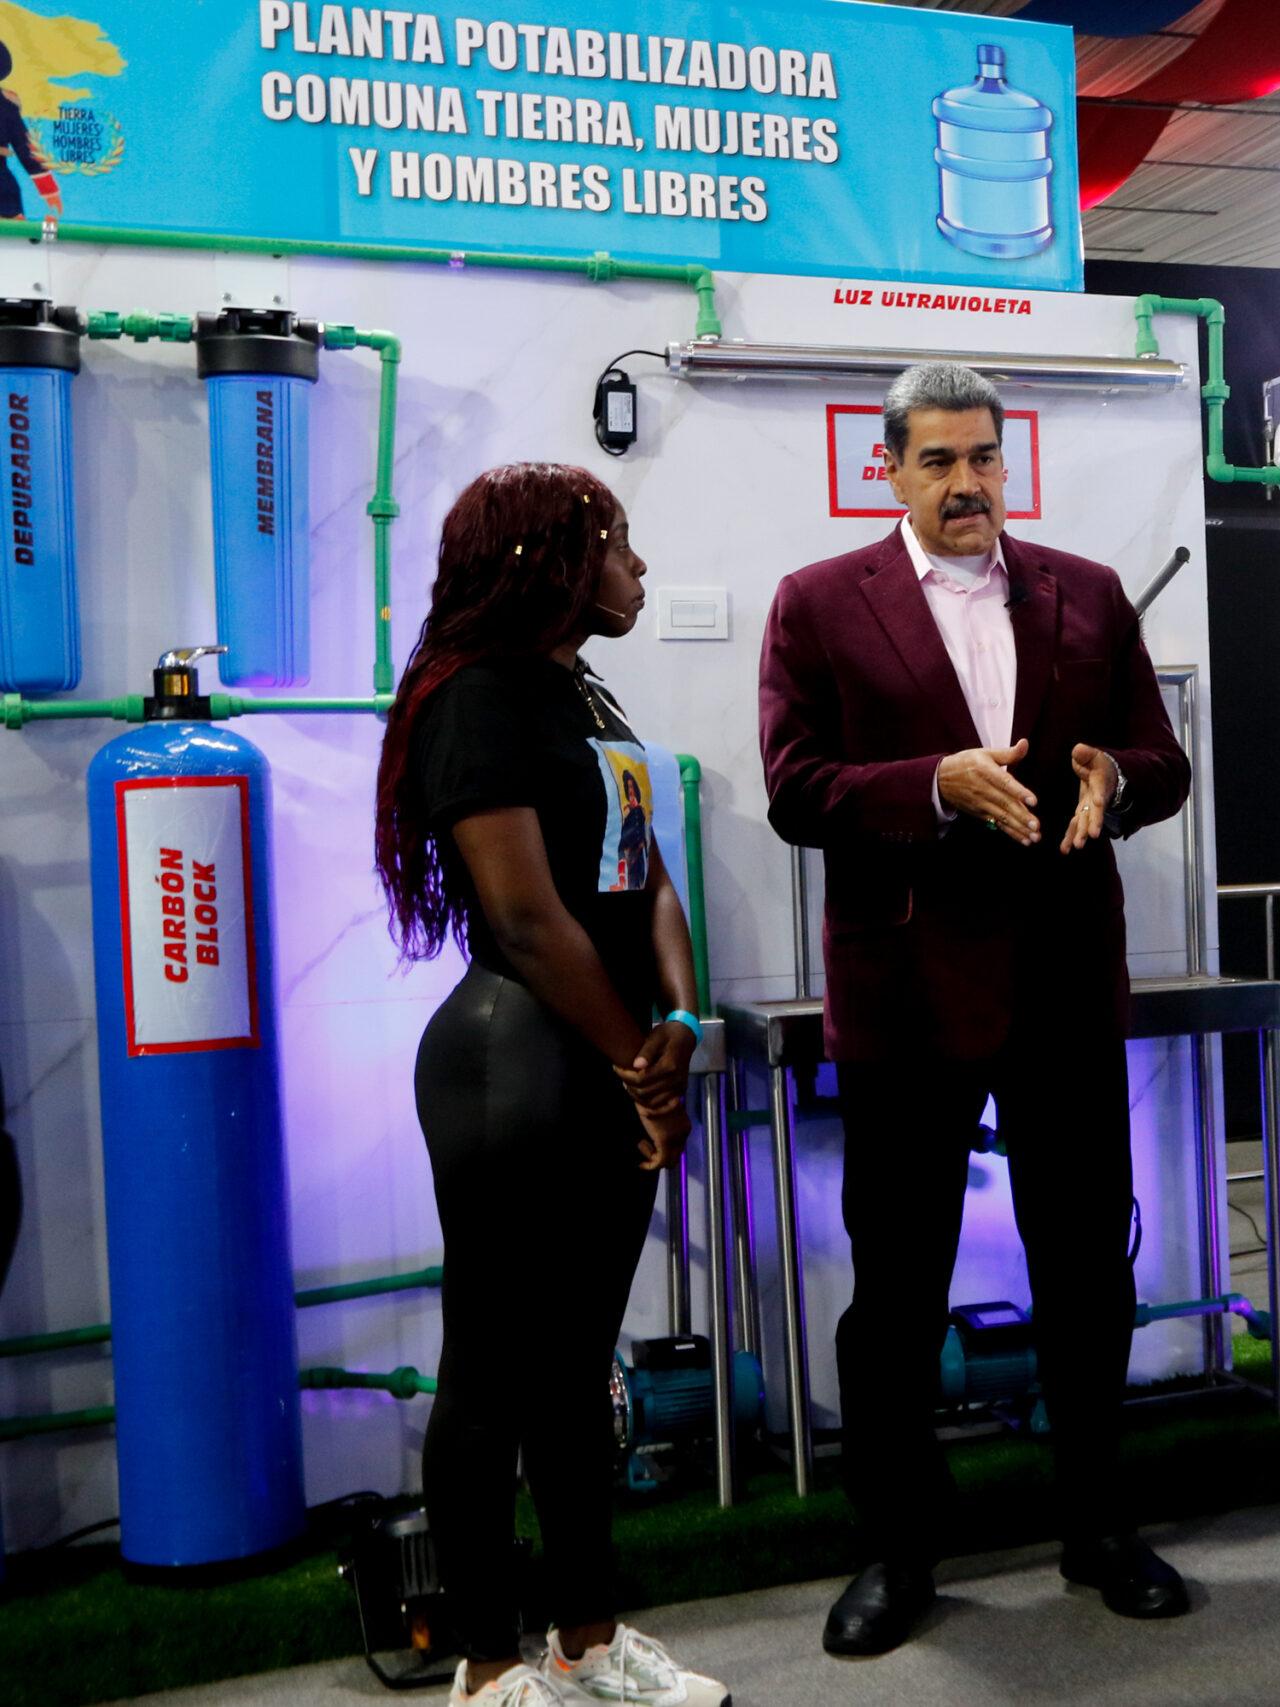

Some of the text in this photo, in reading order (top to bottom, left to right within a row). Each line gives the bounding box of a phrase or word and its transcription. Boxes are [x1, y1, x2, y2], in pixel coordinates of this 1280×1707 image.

[259, 0, 838, 100] PLANTA POTABILIZADORA
[53, 135, 102, 151] HOMBRES
[58, 106, 96, 122] TIERRA
[60, 149, 96, 164] LIBRES
[261, 71, 839, 164] COMUNA TIERRA, MUJERES
[349, 148, 768, 222] Y HOMBRES LIBRES
[833, 289, 1032, 315] LUZ ULTRAVIOLETA
[9, 393, 34, 567] DEPURADOR
[257, 390, 275, 536] MEMBRANA
[155, 847, 188, 984] CARBÓN
[193, 859, 220, 966] BLOCK
